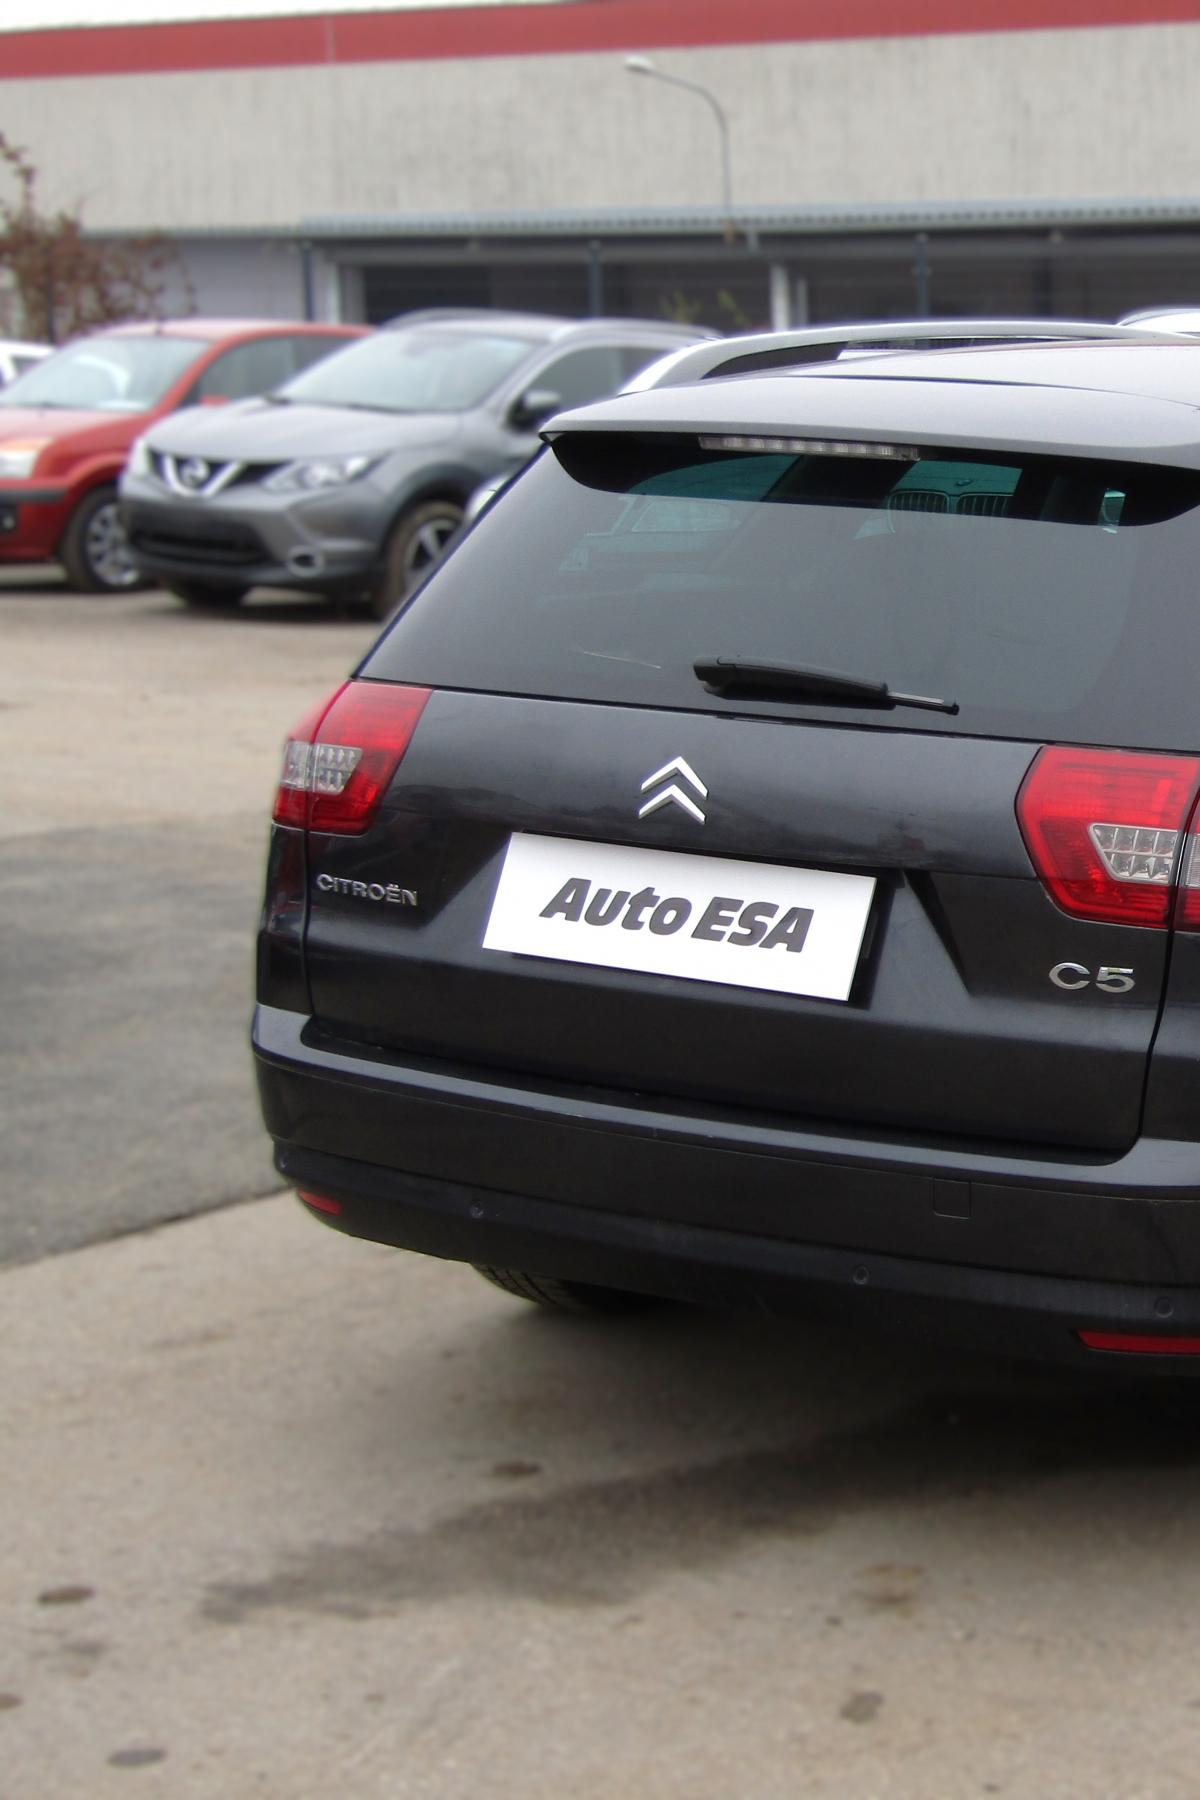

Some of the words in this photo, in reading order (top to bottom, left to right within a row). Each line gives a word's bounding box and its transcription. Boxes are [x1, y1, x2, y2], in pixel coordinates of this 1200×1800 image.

[316, 873, 418, 906] CITROËN
[539, 878, 692, 936] Auto
[691, 896, 815, 953] ESA
[1048, 962, 1136, 993] C5
